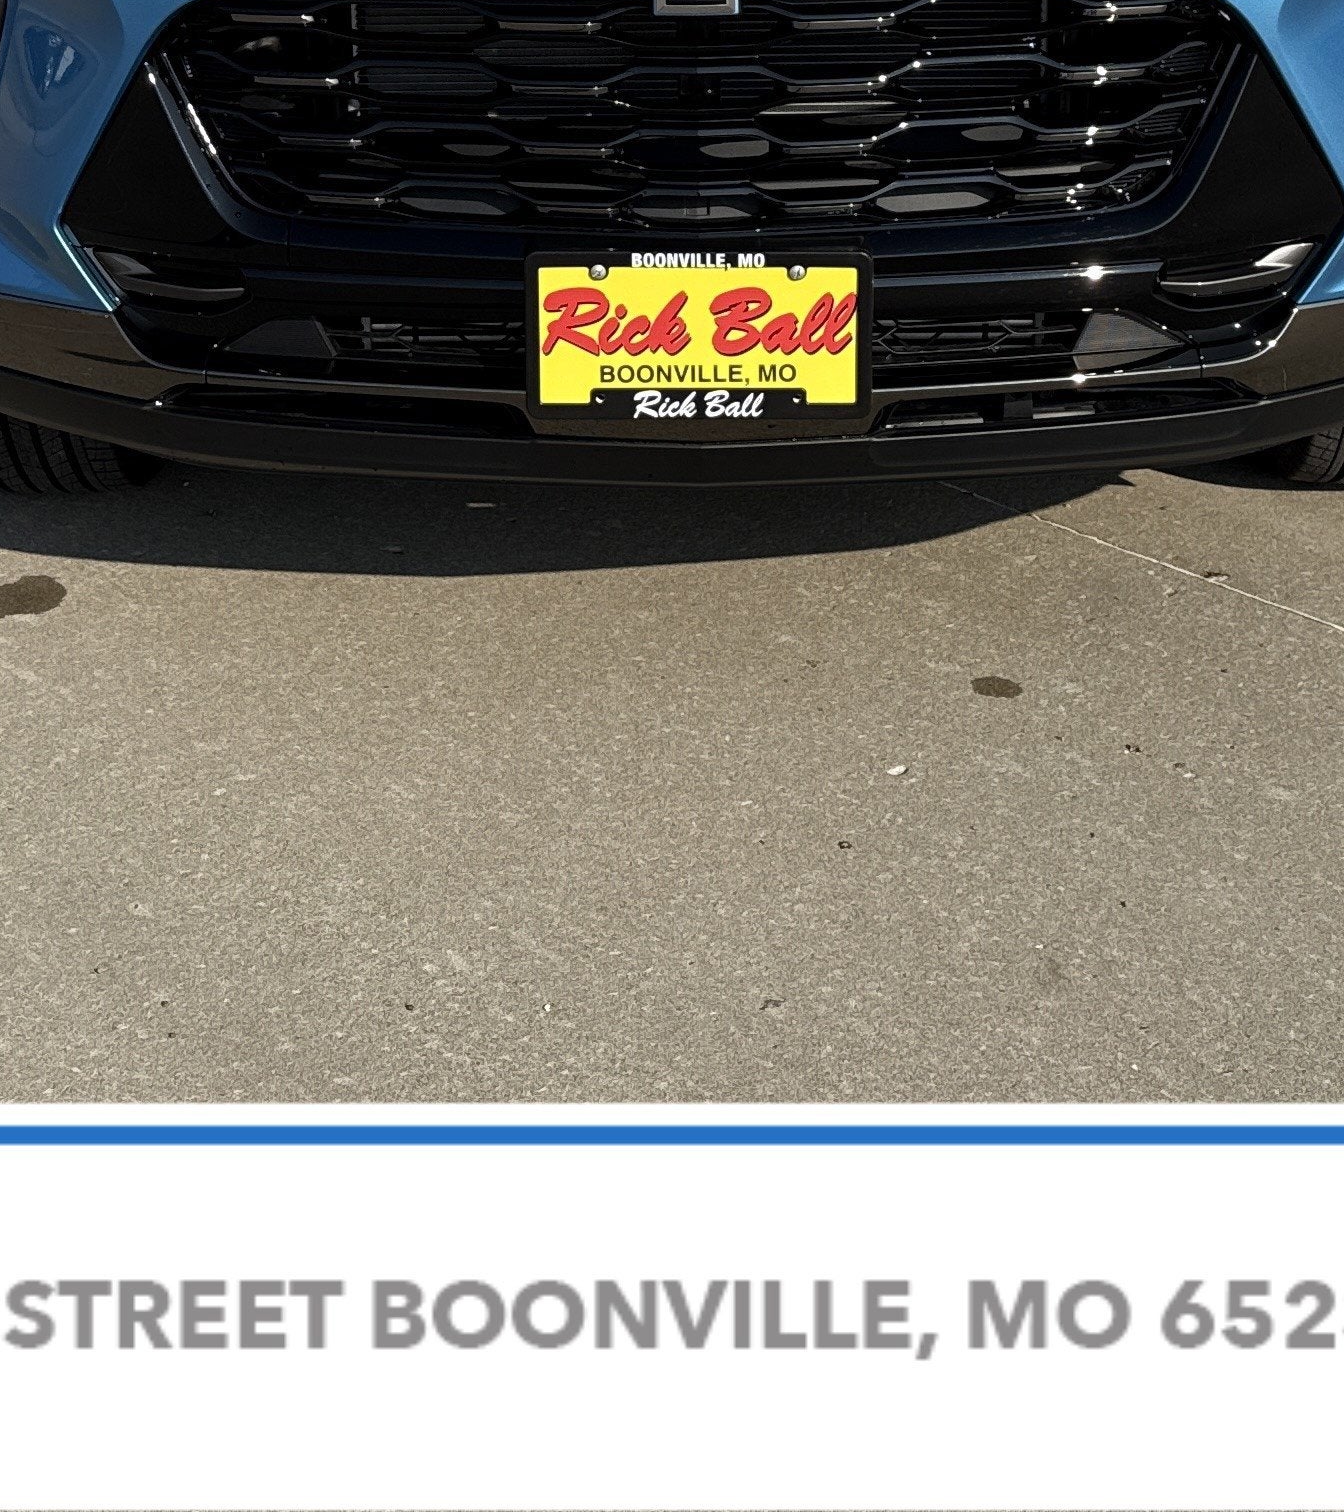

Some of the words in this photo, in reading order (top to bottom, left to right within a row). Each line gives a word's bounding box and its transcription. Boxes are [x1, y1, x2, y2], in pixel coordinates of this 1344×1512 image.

[630, 252, 732, 270] BOONVILLE,
[737, 252, 766, 268] MO
[542, 286, 692, 357] Rick
[709, 286, 858, 357] Ball
[599, 364, 751, 386] BOONVILLE,
[758, 363, 797, 383] MO
[632, 389, 698, 420] Rick
[704, 391, 765, 419] Ball
